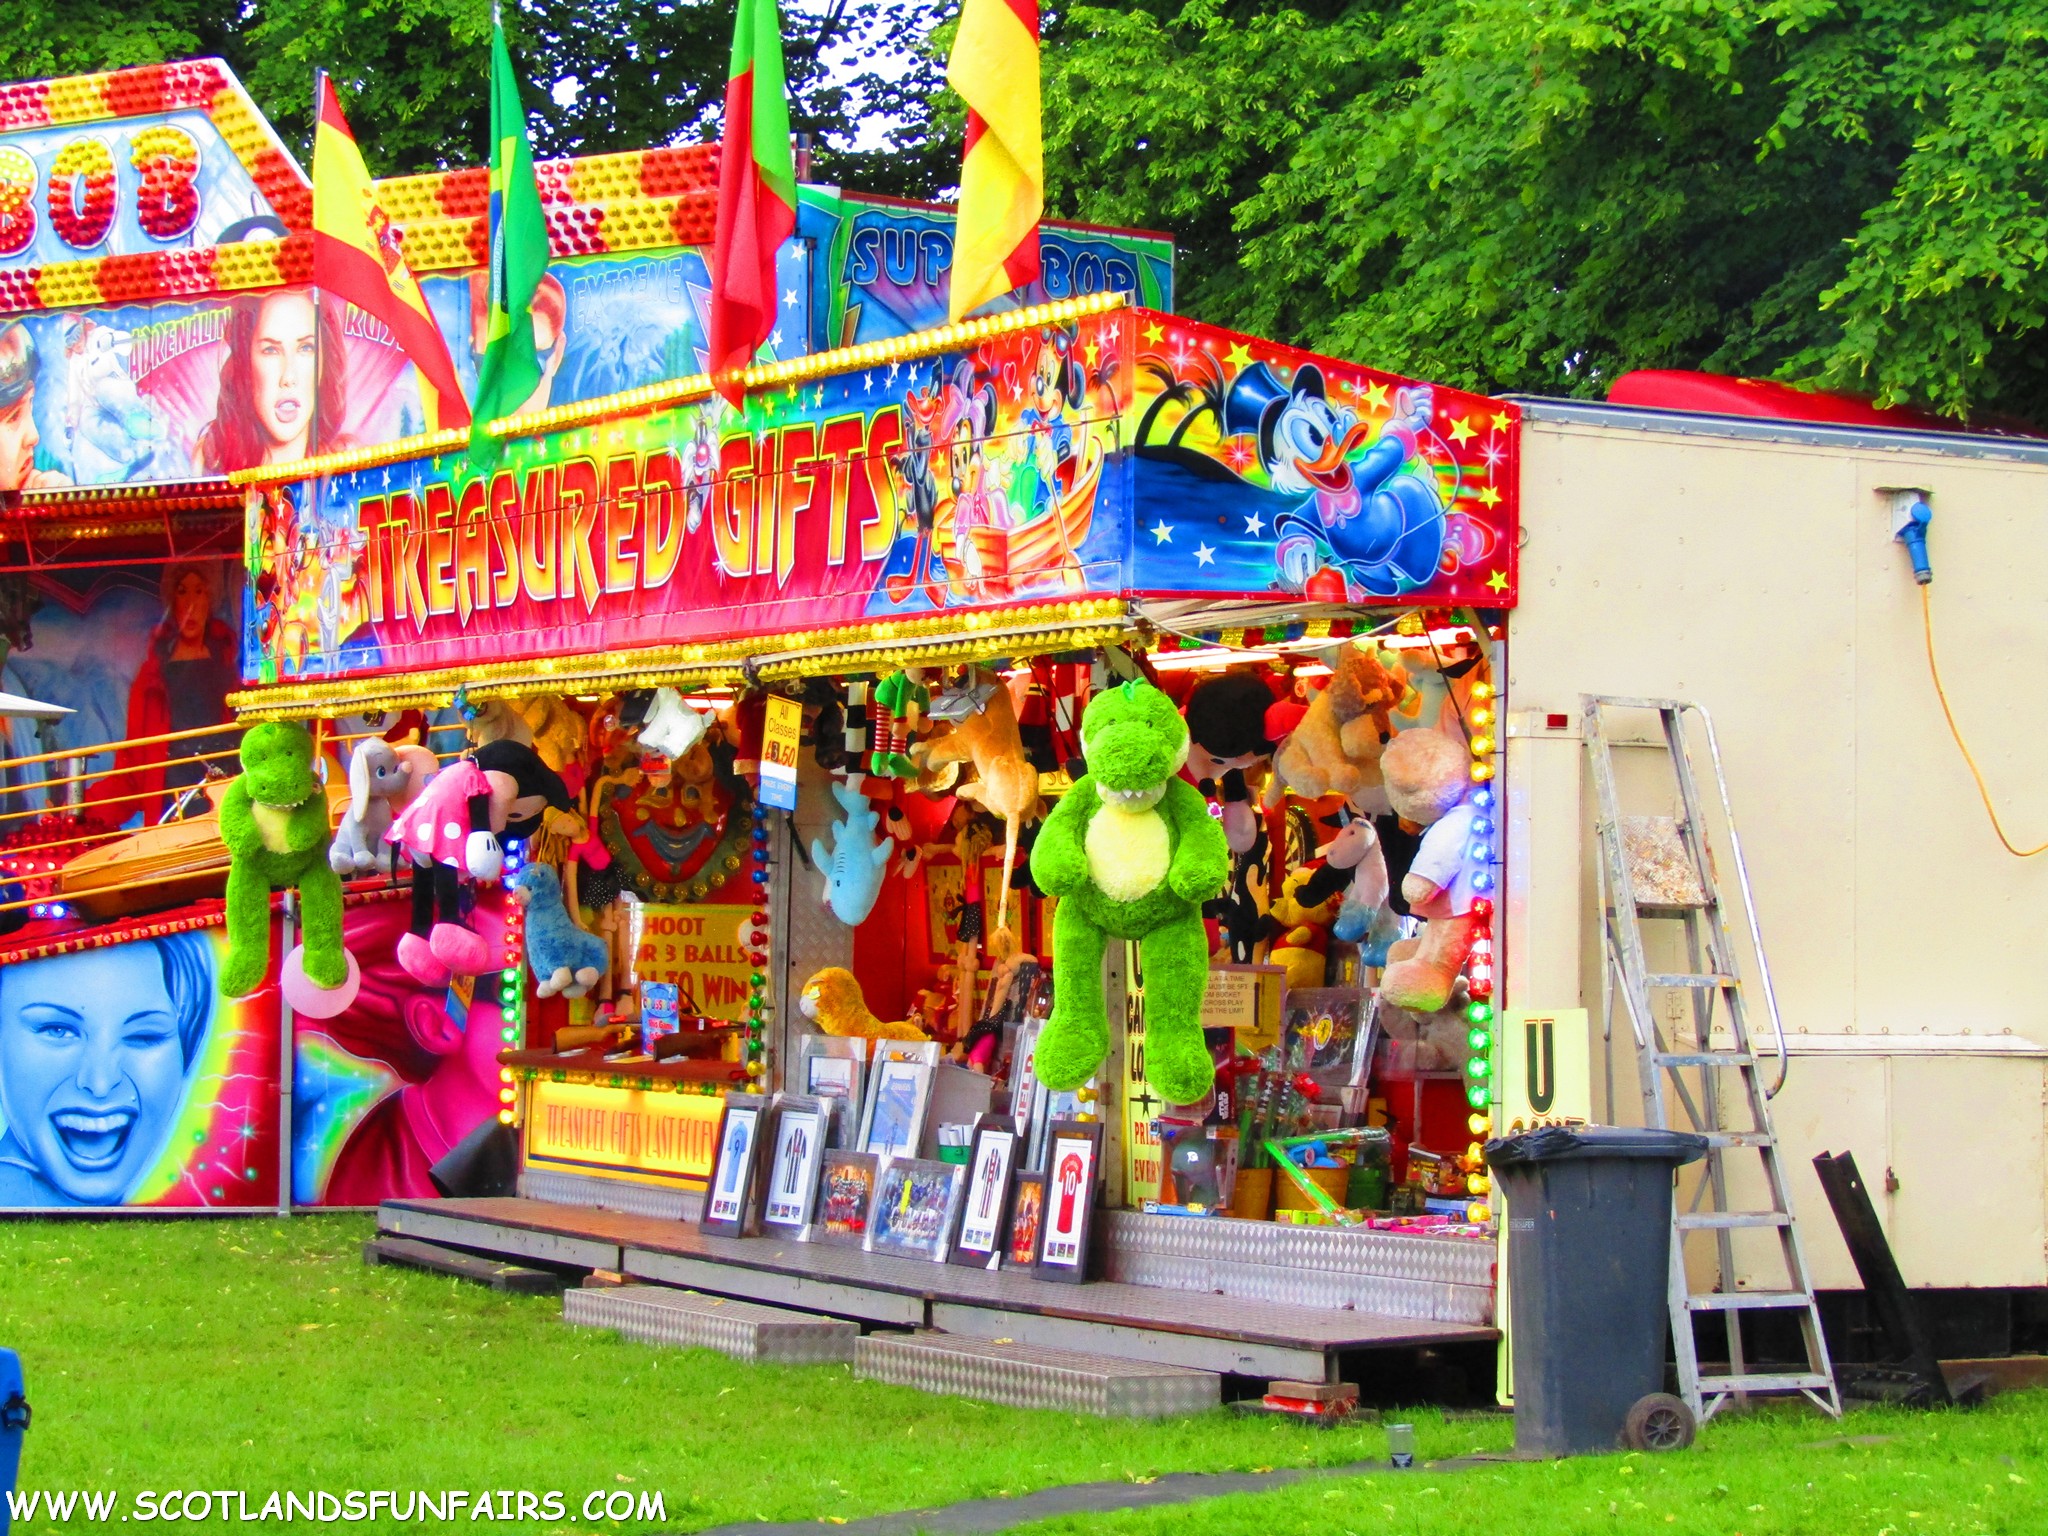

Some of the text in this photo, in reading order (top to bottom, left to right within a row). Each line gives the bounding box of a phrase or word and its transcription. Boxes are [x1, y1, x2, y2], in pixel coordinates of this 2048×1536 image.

[852, 228, 956, 286] SUP
[572, 257, 683, 333] EXTREME
[358, 404, 903, 634] TREASURED GIFTS
[779, 704, 789, 721] All
[643, 917, 705, 936] HOOT
[665, 944, 677, 962] 3
[684, 945, 749, 964] BALLS
[703, 973, 748, 1008] WIN
[1523, 1019, 1556, 1117] U
[611, 1110, 641, 1157] GIFTS
[646, 1114, 676, 1160] LAST
[678, 1118, 722, 1165] FOREV
[1064, 1170, 1076, 1195] 10
